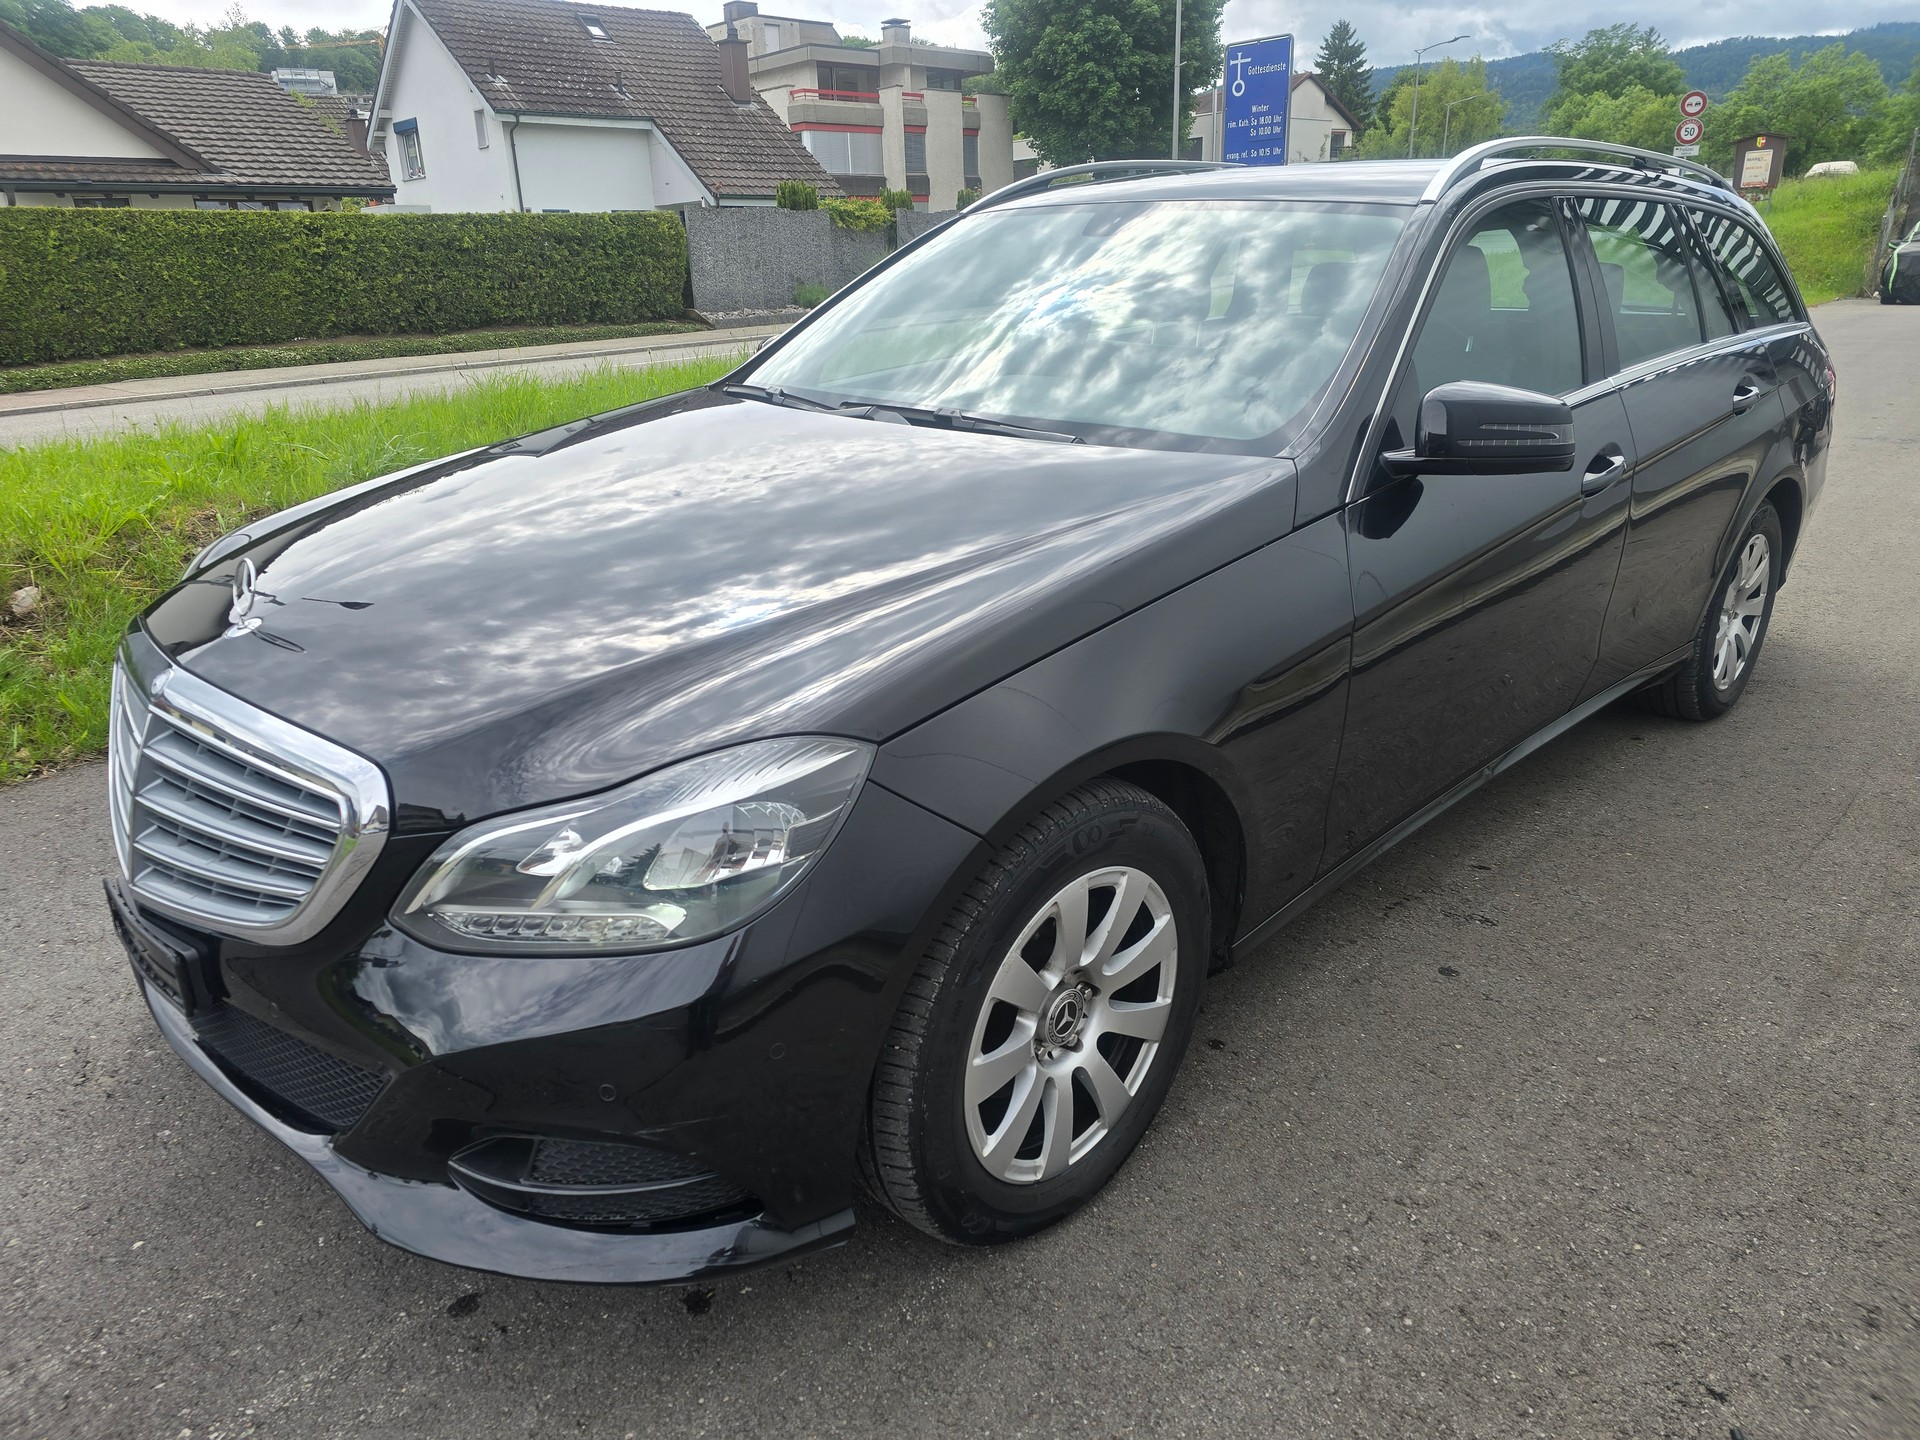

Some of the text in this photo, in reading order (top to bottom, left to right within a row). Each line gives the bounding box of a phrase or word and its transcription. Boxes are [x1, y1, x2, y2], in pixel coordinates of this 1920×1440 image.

[1248, 61, 1286, 75] Gottesdienste
[1252, 104, 1269, 113] Winter
[1251, 117, 1257, 126] Sa
[1259, 115, 1272, 124] 18.00
[1273, 115, 1282, 123] Uhr
[1250, 125, 1282, 136] So 10.00 Uhr
[1684, 127, 1695, 136] 50
[1227, 152, 1240, 161] evang.
[1250, 149, 1257, 158] So
[1259, 147, 1271, 156] 10.15
[1273, 146, 1282, 155] Uhr
